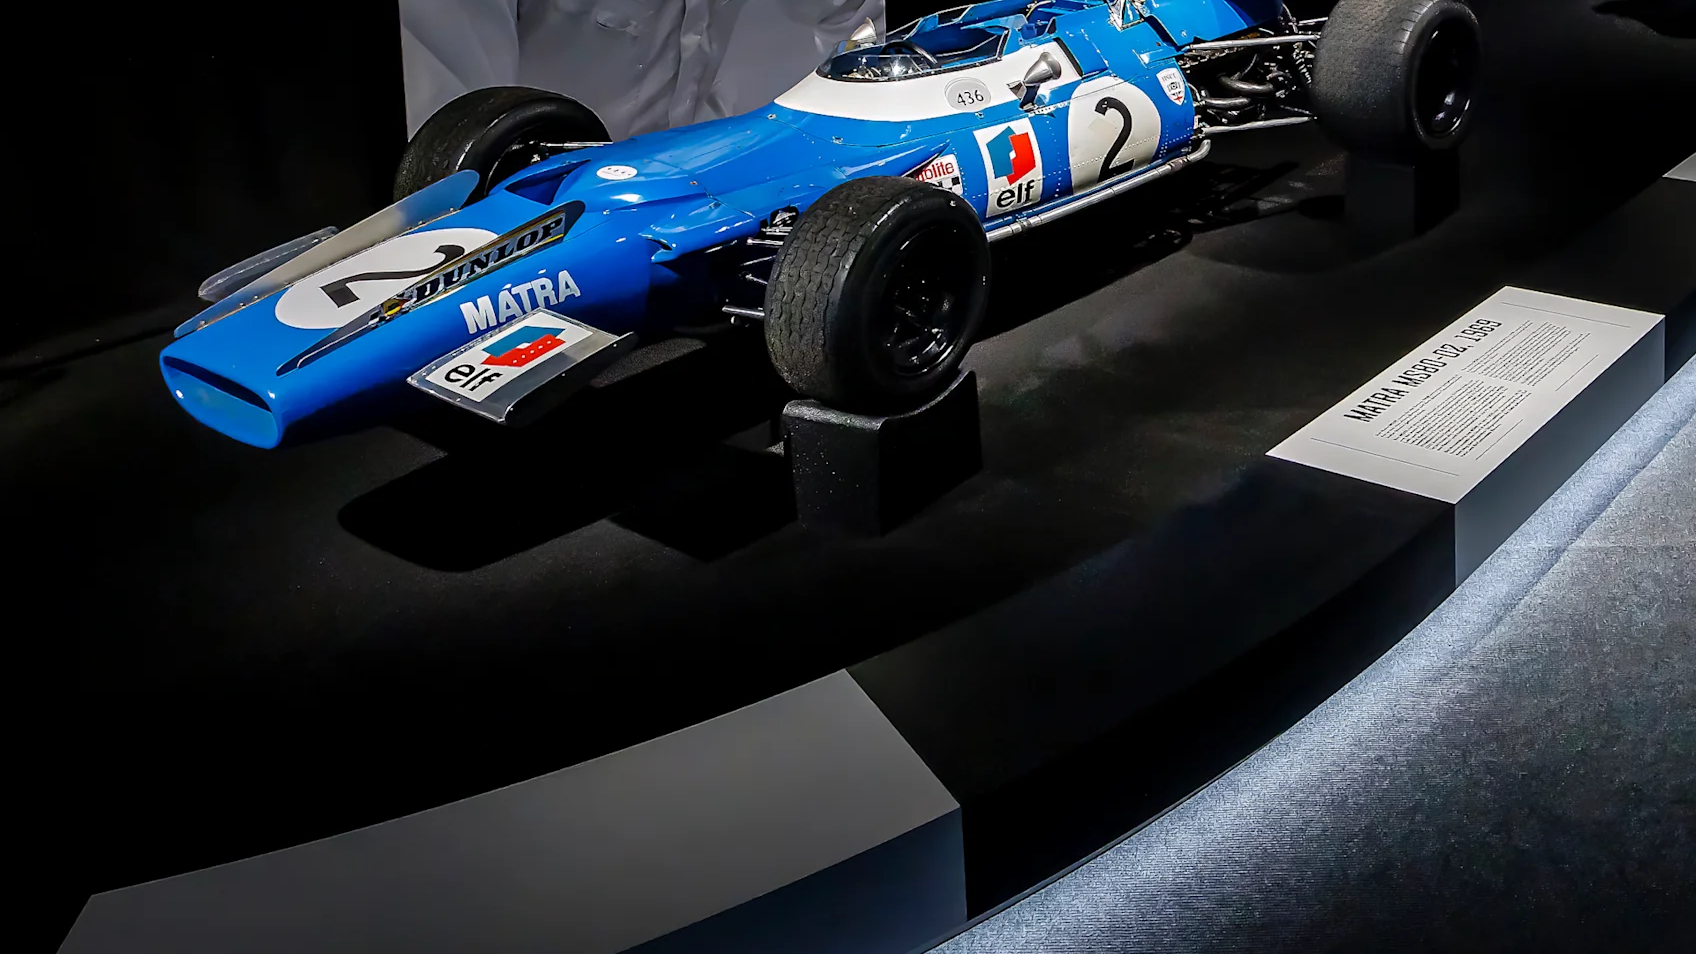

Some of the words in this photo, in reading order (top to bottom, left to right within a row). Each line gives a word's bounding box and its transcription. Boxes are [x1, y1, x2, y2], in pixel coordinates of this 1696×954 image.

[957, 90, 984, 107] 436
[1094, 96, 1135, 184] 2
[996, 179, 1036, 209] elf
[319, 244, 466, 308] 2
[414, 216, 565, 303] DUNLOP
[460, 270, 582, 335] MATRA
[444, 363, 504, 392] elf
[1343, 387, 1410, 422] MATRA
[1454, 318, 1502, 342] 1969
